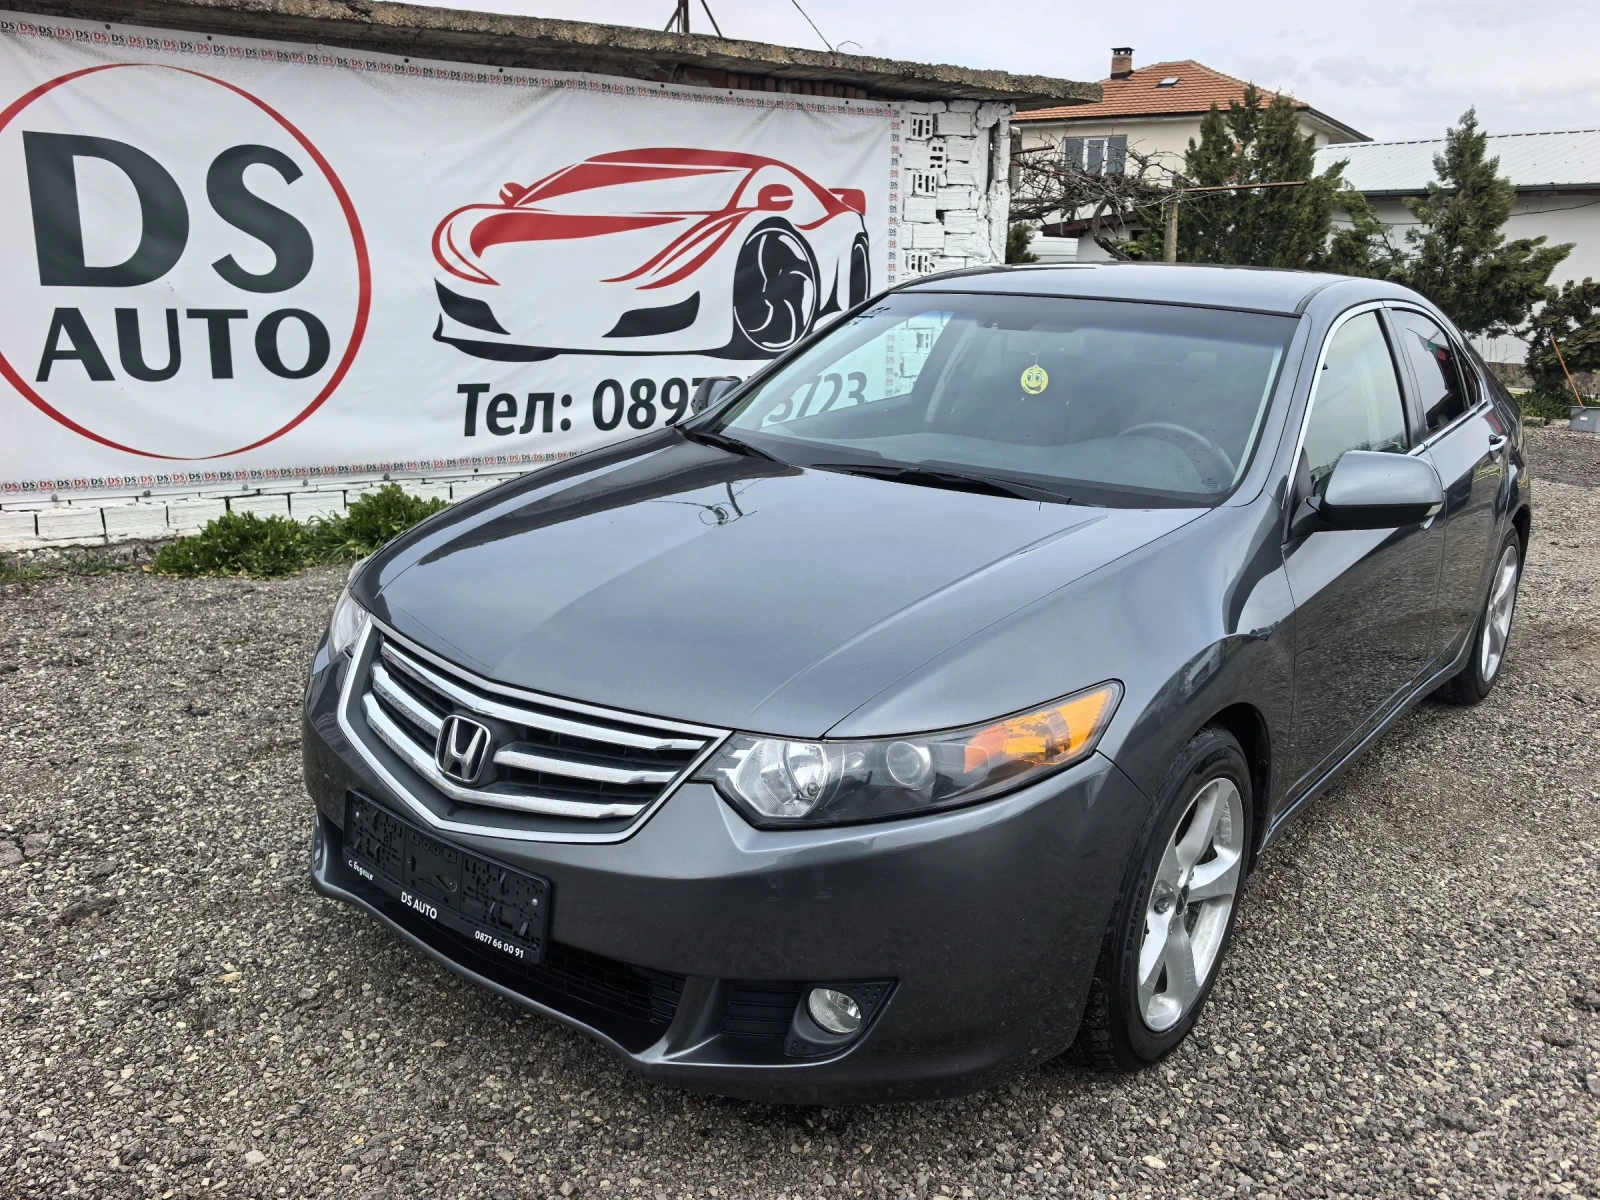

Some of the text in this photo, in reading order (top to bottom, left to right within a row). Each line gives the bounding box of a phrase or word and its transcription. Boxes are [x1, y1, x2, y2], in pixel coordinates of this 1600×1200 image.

[20, 23, 34, 31] DS
[39, 25, 52, 34] DS
[57, 27, 71, 36] DS
[75, 30, 88, 38] DS
[94, 32, 106, 40] DS
[111, 34, 124, 42] DS
[129, 36, 141, 44] DS
[163, 39, 175, 47] DS
[22, 130, 314, 293] DS
[36, 307, 330, 382] AUTO
[456, 382, 572, 436] Тел:
[401, 891, 438, 920] DS AUTO
[475, 930, 524, 958] 0877 66 00 91
